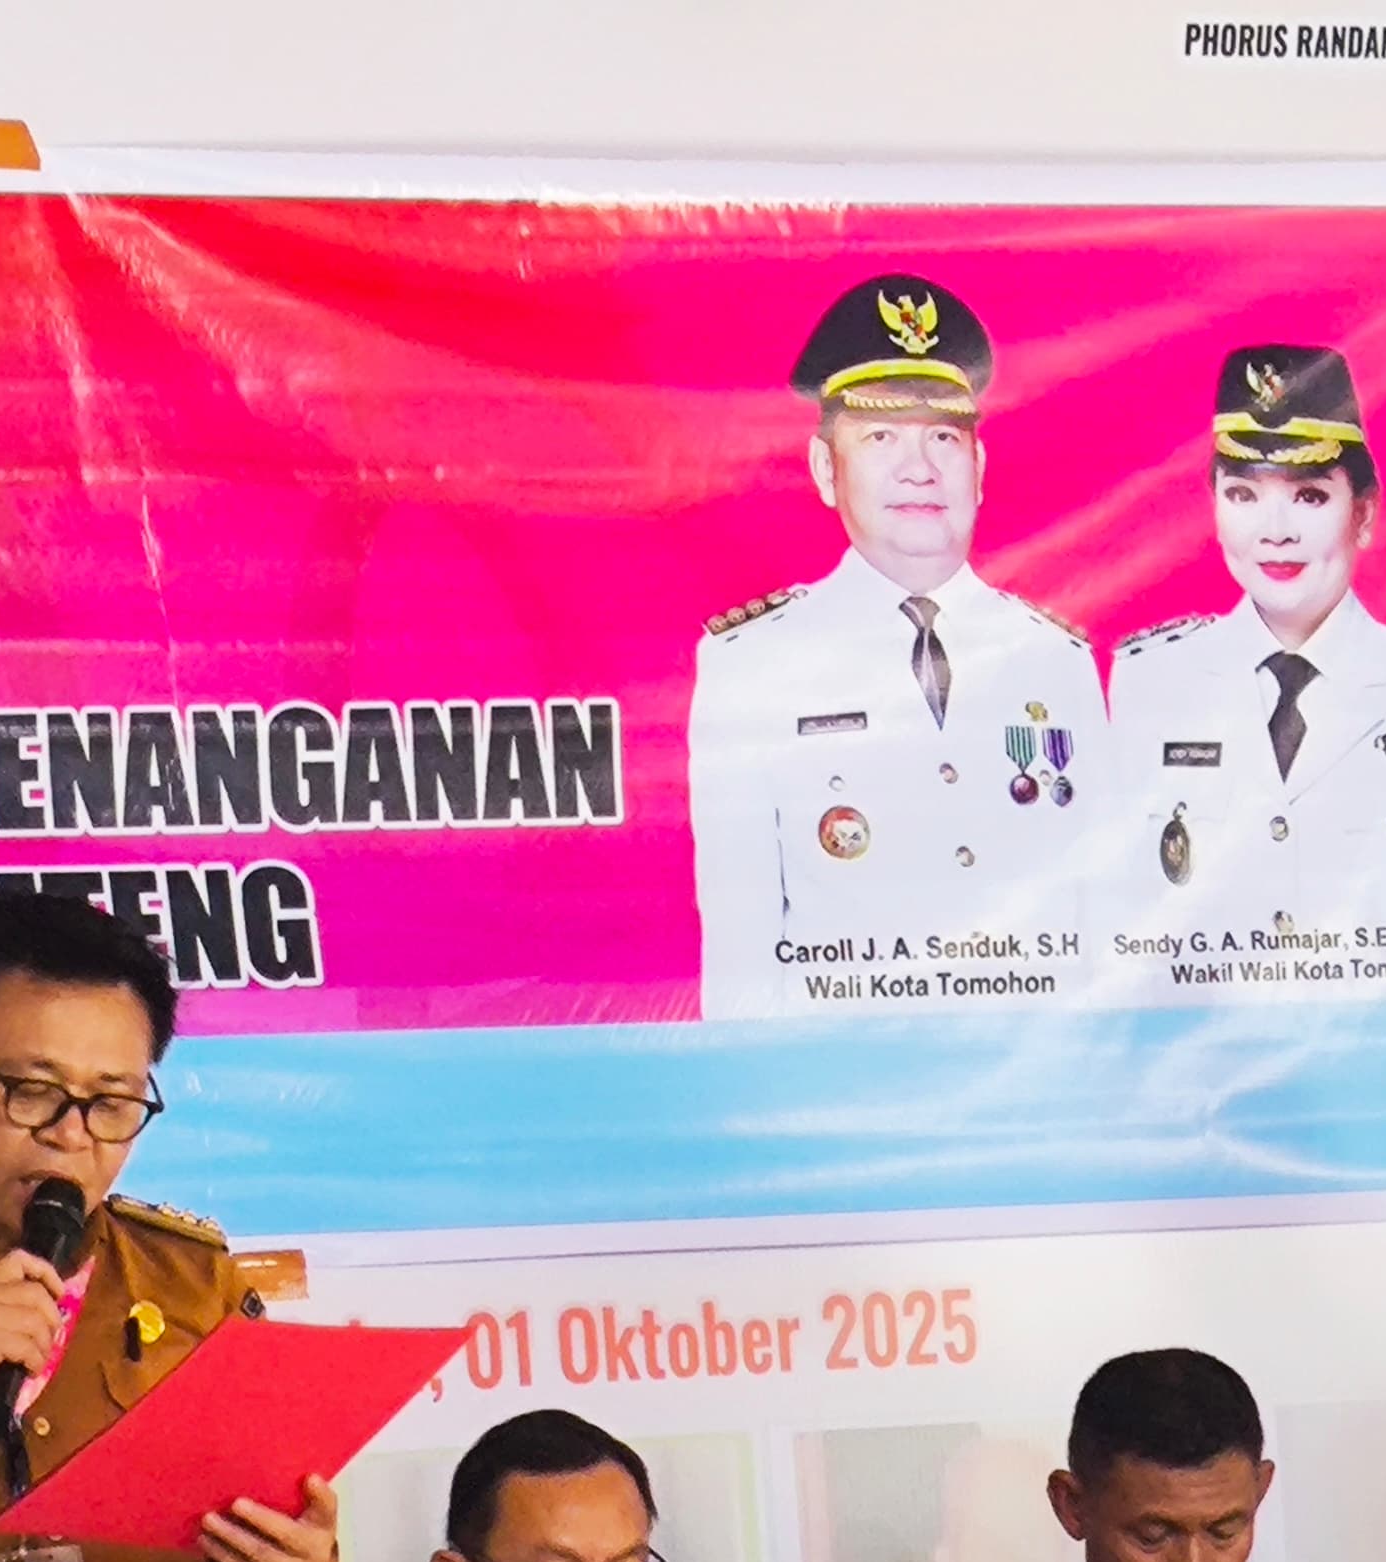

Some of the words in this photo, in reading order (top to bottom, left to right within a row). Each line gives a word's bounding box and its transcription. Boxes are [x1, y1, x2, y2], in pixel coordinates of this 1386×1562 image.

[1185, 24, 1287, 58] PHORUS
[775, 938, 853, 963] Caroll
[862, 939, 884, 962] J.
[893, 937, 918, 960] A.
[927, 933, 1029, 962] Senduk,
[1038, 932, 1079, 957] S.H
[1114, 931, 1183, 959] Sendy
[1190, 932, 1214, 955] G.
[1221, 930, 1244, 953] A.
[1251, 928, 1349, 956] Rumajar,
[806, 974, 862, 1000] Wali
[870, 974, 929, 998] Kota
[935, 971, 1055, 996] Tomohon
[1171, 960, 1233, 985] Wakil
[1238, 959, 1287, 984] Wali
[1294, 958, 1344, 982] Kota
[466, 1311, 532, 1390] 01
[558, 1299, 801, 1387] Oktober
[821, 1287, 979, 1372] 2025
